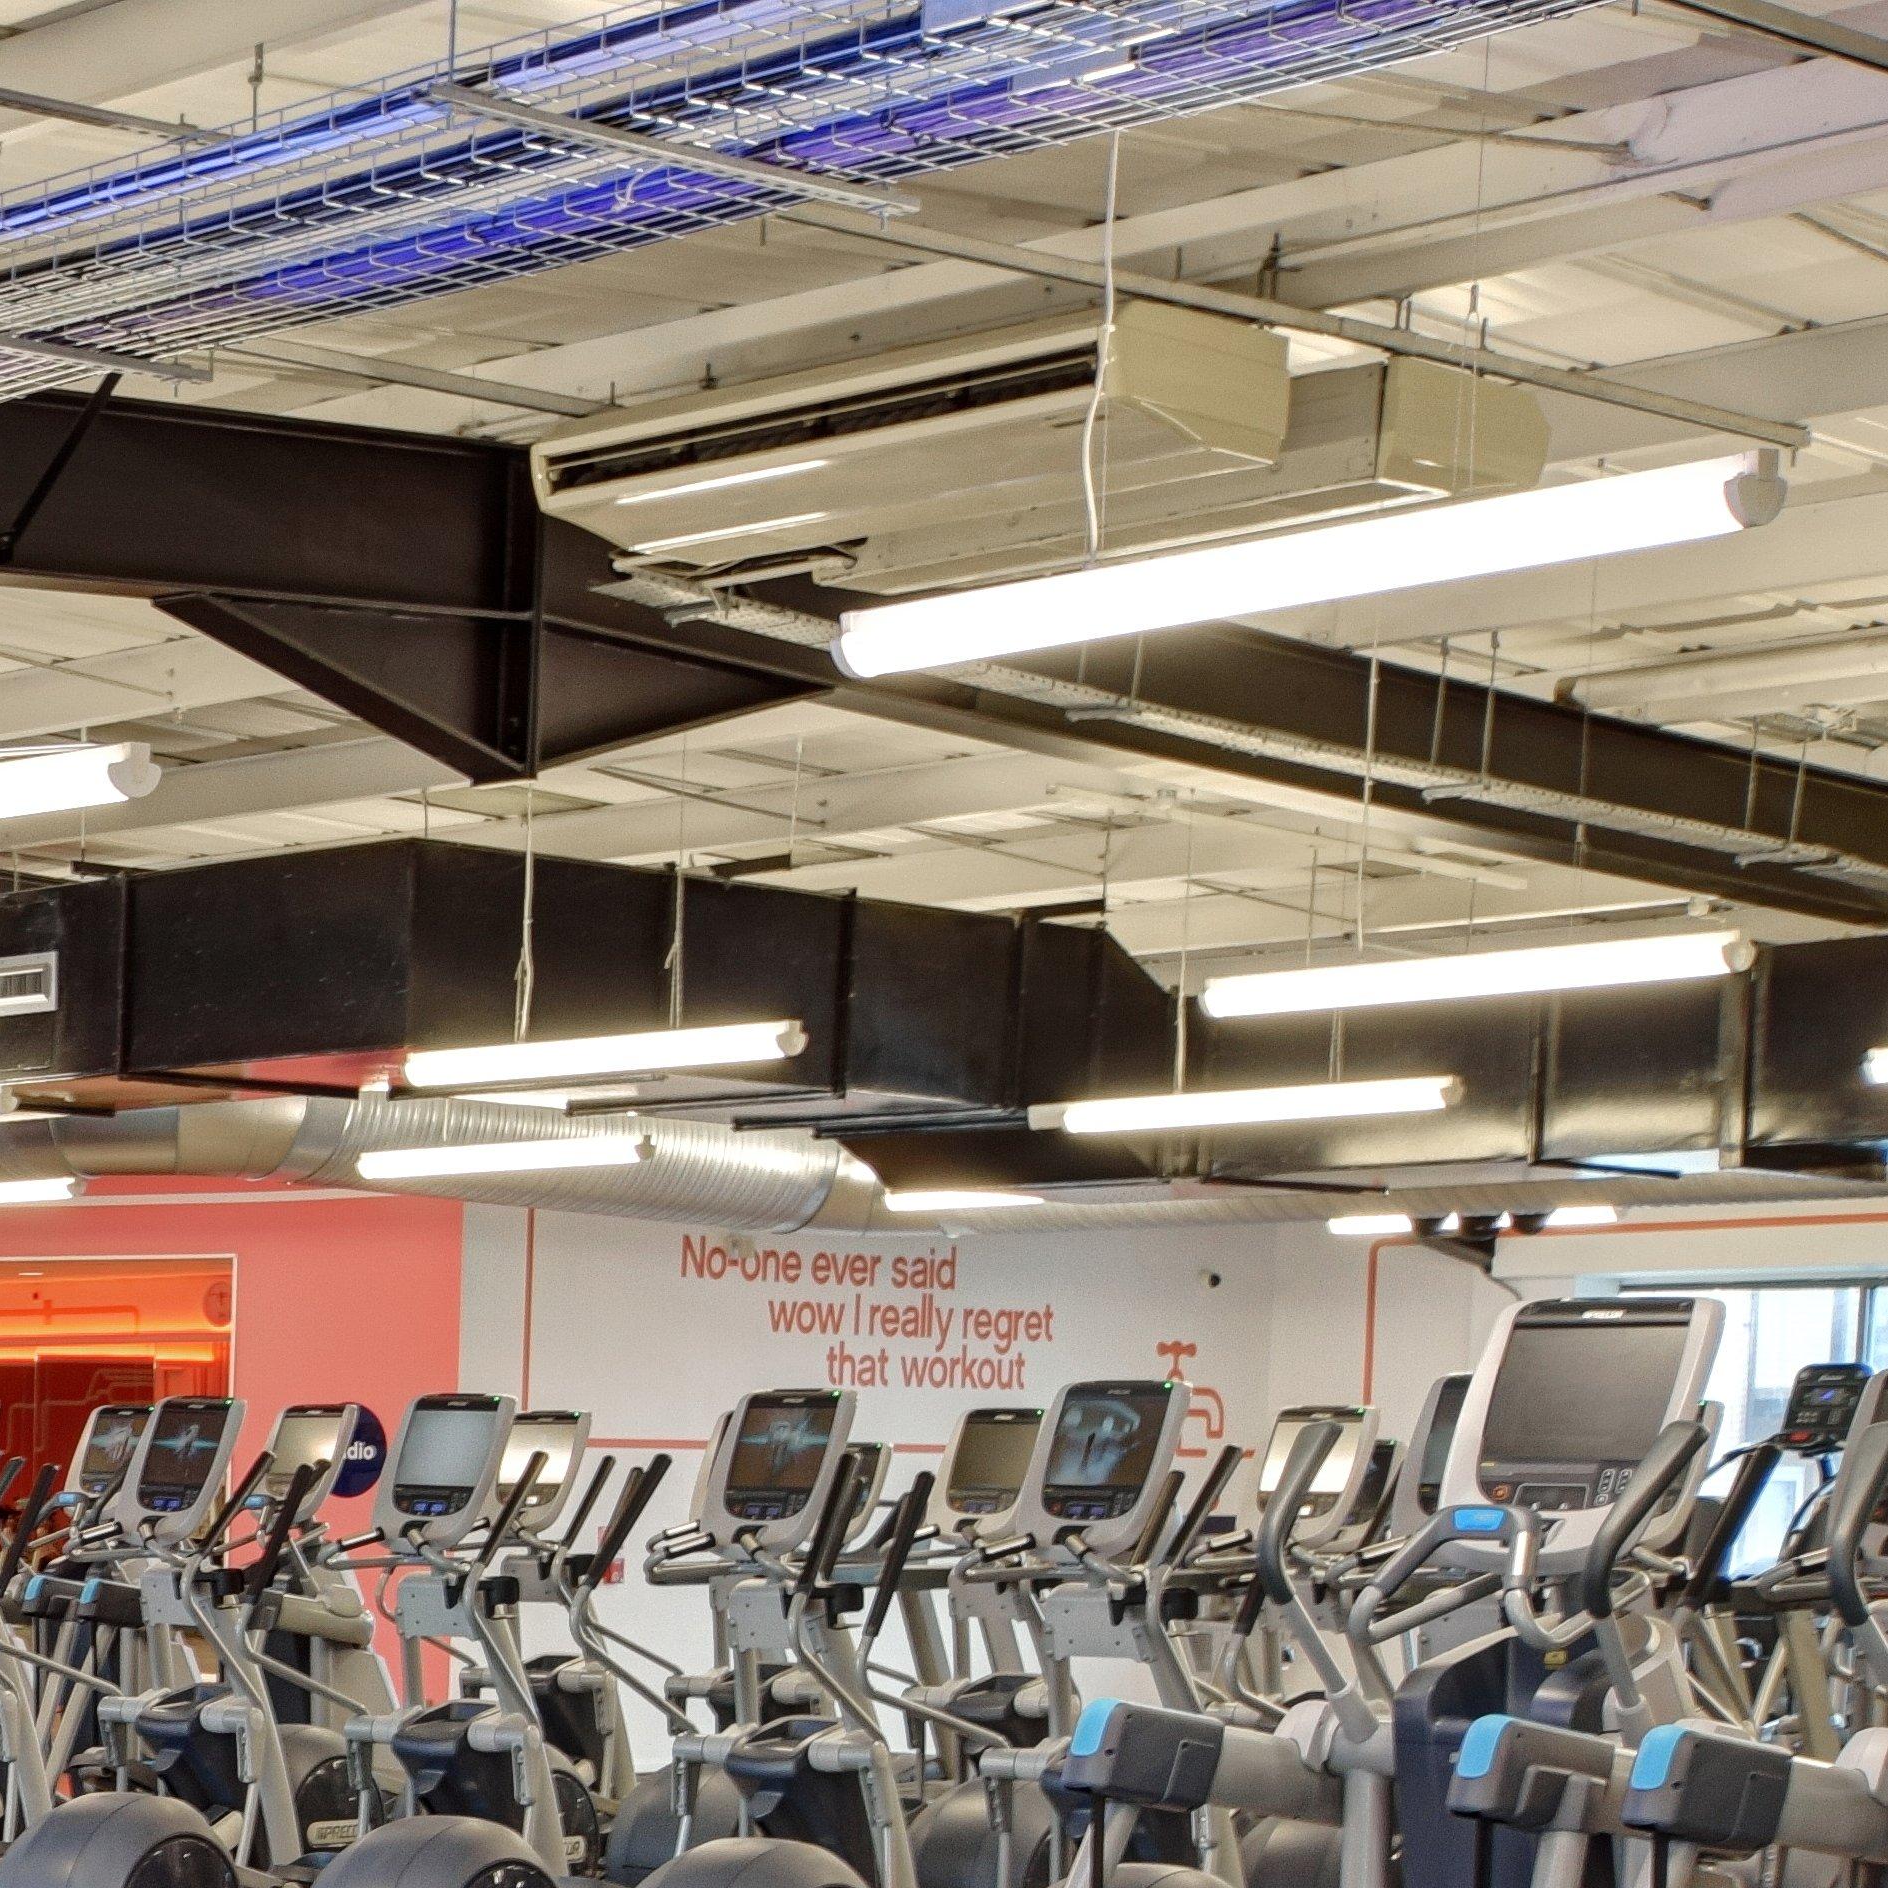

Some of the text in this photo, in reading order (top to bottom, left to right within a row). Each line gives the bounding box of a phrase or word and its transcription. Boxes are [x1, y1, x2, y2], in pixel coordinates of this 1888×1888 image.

[680, 1234, 958, 1289] No-one ever said
[769, 1293, 1053, 1354] wow I really regret
[827, 1340, 1025, 1389] that workout
[324, 1824, 357, 1839] PREC
